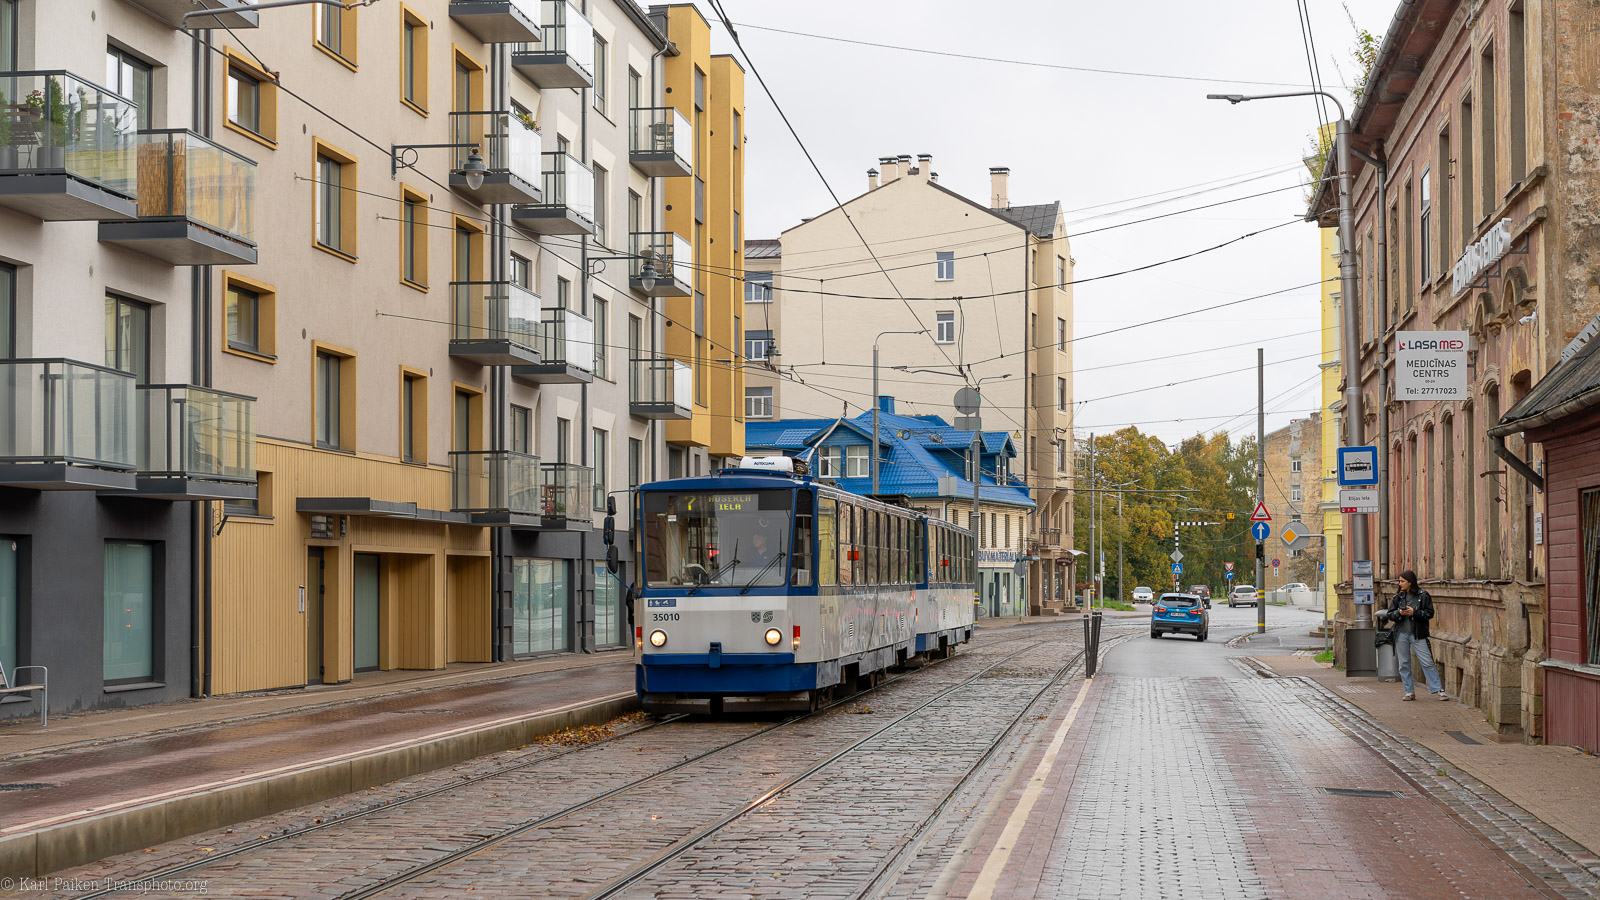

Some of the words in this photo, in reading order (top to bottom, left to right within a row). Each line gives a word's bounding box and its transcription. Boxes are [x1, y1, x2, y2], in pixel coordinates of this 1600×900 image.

[1406, 358, 1457, 368] MEDICĪNAS
[1412, 369, 1450, 378] CENTRS
[1405, 387, 1419, 395] Tel:
[1421, 387, 1457, 395] 27717023
[719, 503, 742, 511] IELA
[652, 612, 680, 621] 35010
